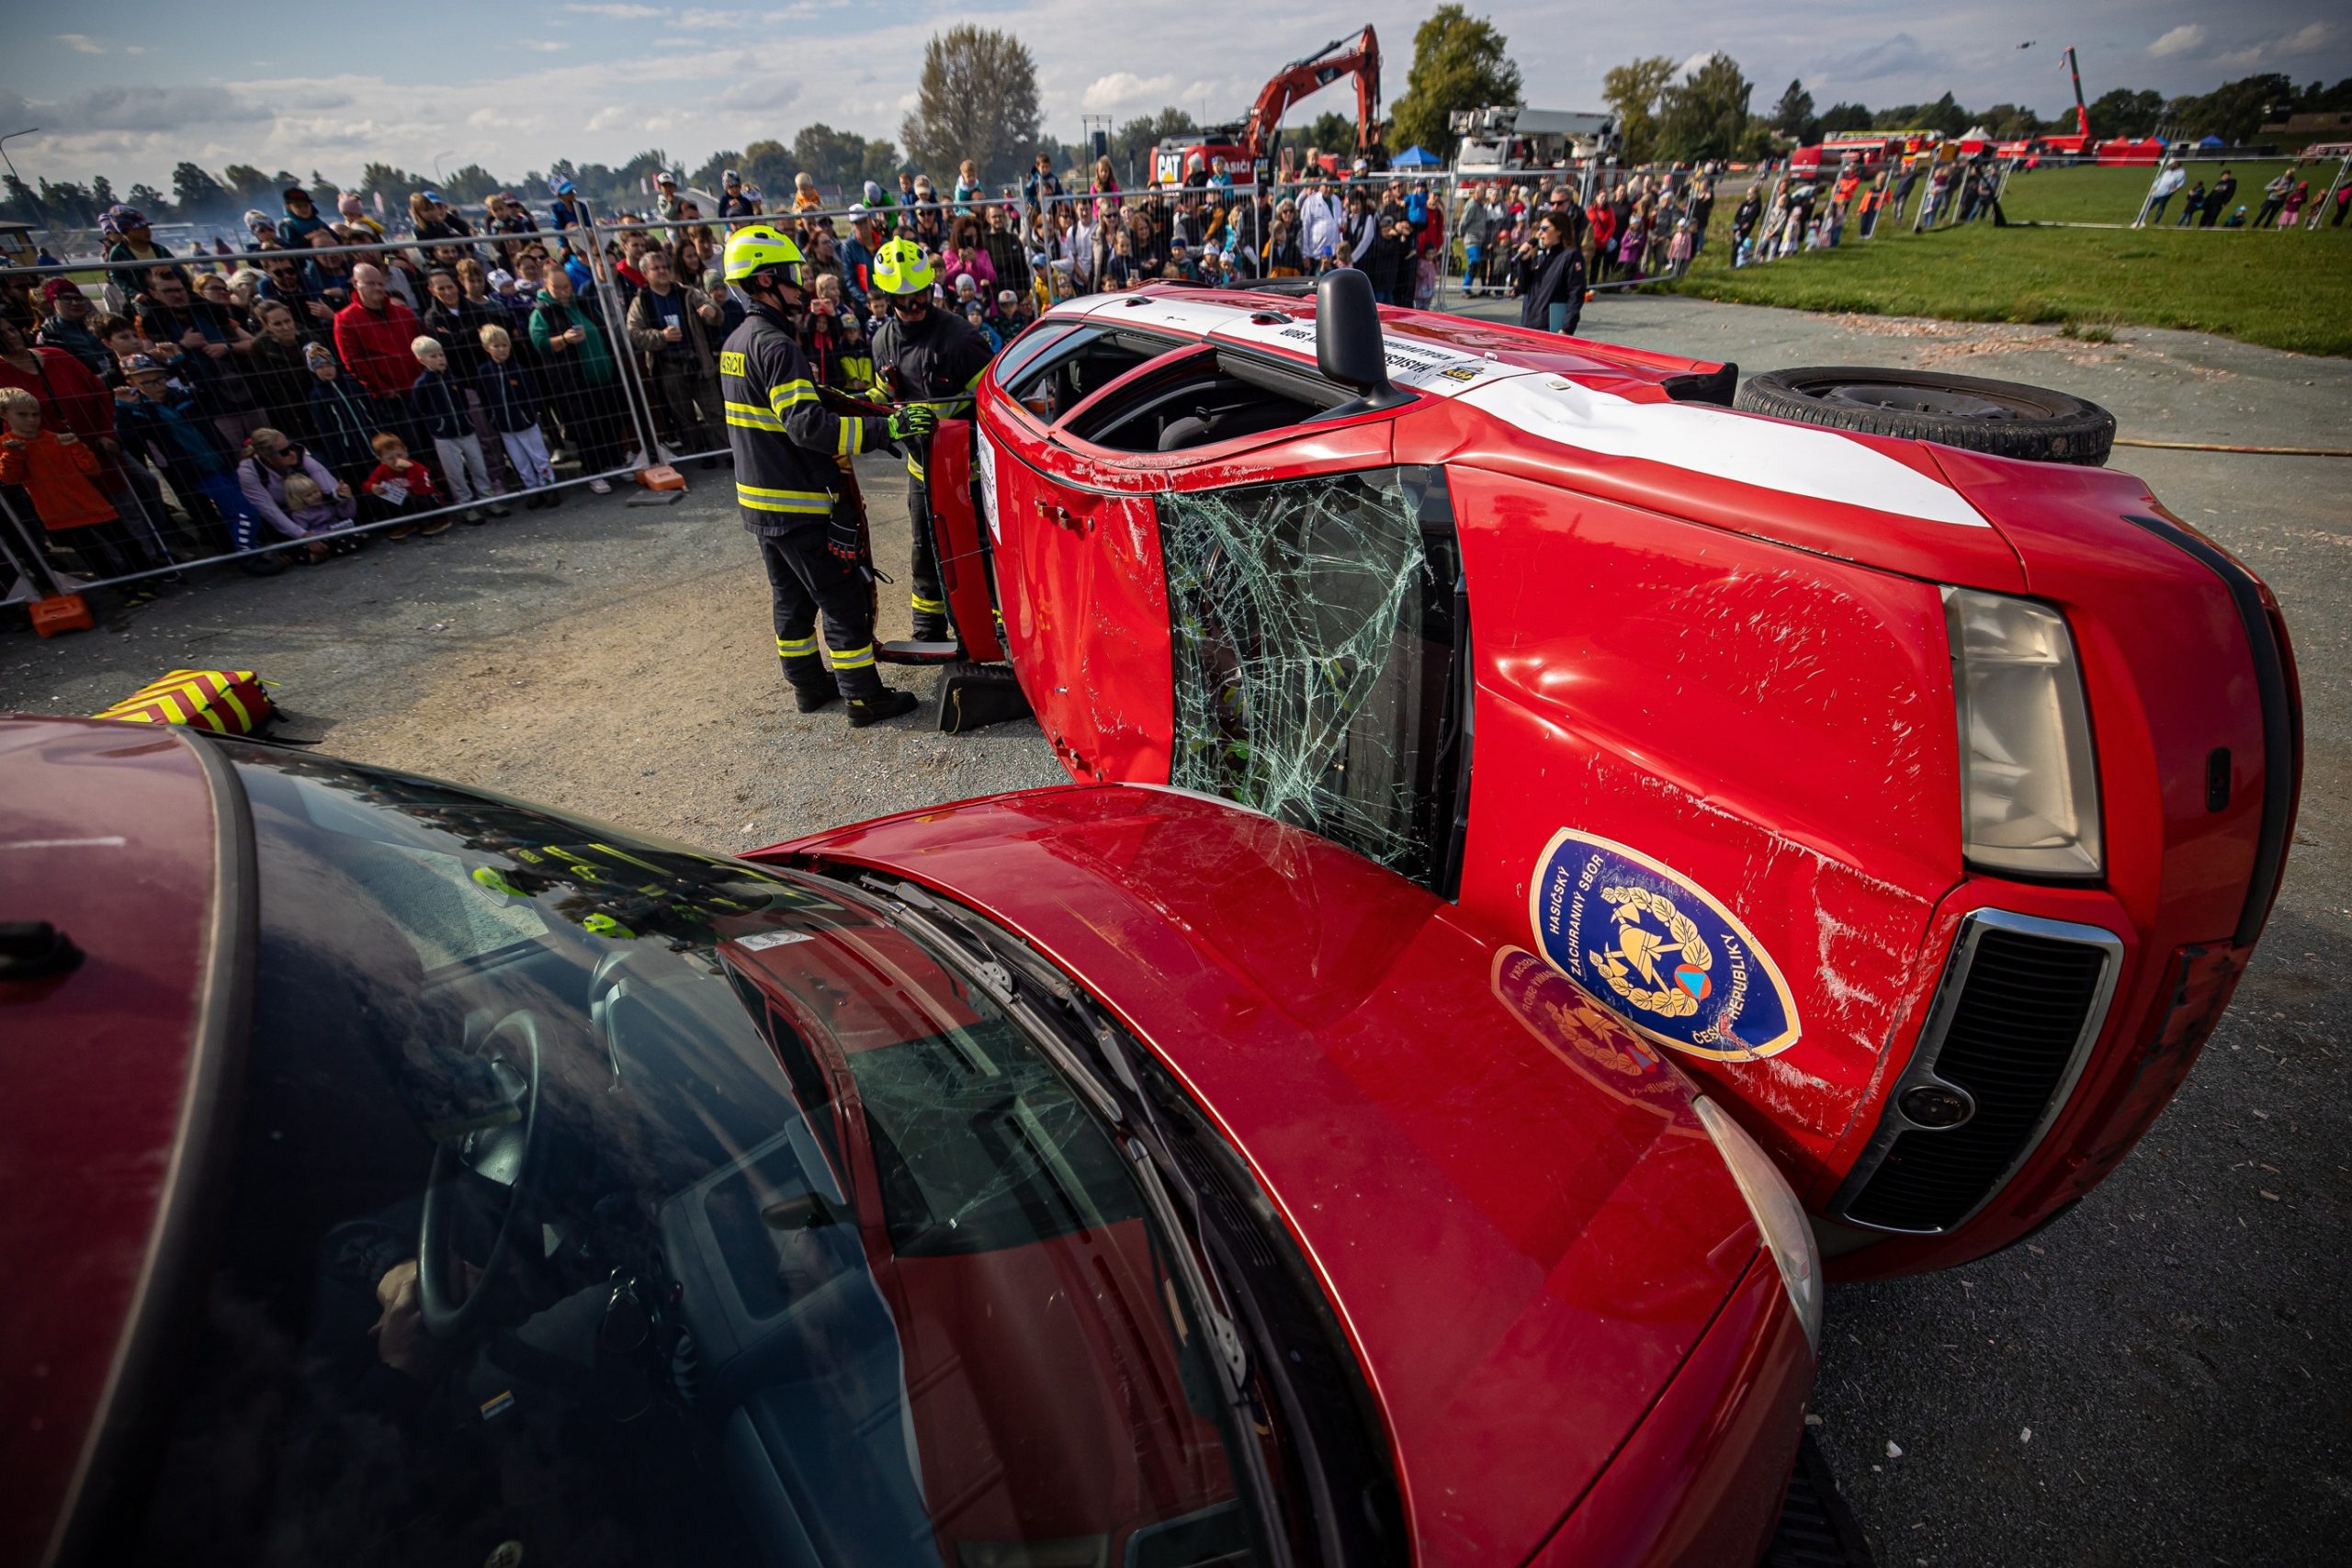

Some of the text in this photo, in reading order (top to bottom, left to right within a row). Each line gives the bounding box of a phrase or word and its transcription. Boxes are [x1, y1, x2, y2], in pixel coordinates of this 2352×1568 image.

[1158, 154, 1181, 183] CAT
[1224, 159, 1250, 174] ASIČI
[722, 354, 741, 374] ASIČI
[1384, 353, 1433, 373] HASIČS
[1549, 865, 1570, 935] HASIČSKÝ
[1567, 853, 1604, 976] ZÁCHRANNÝ SBOR
